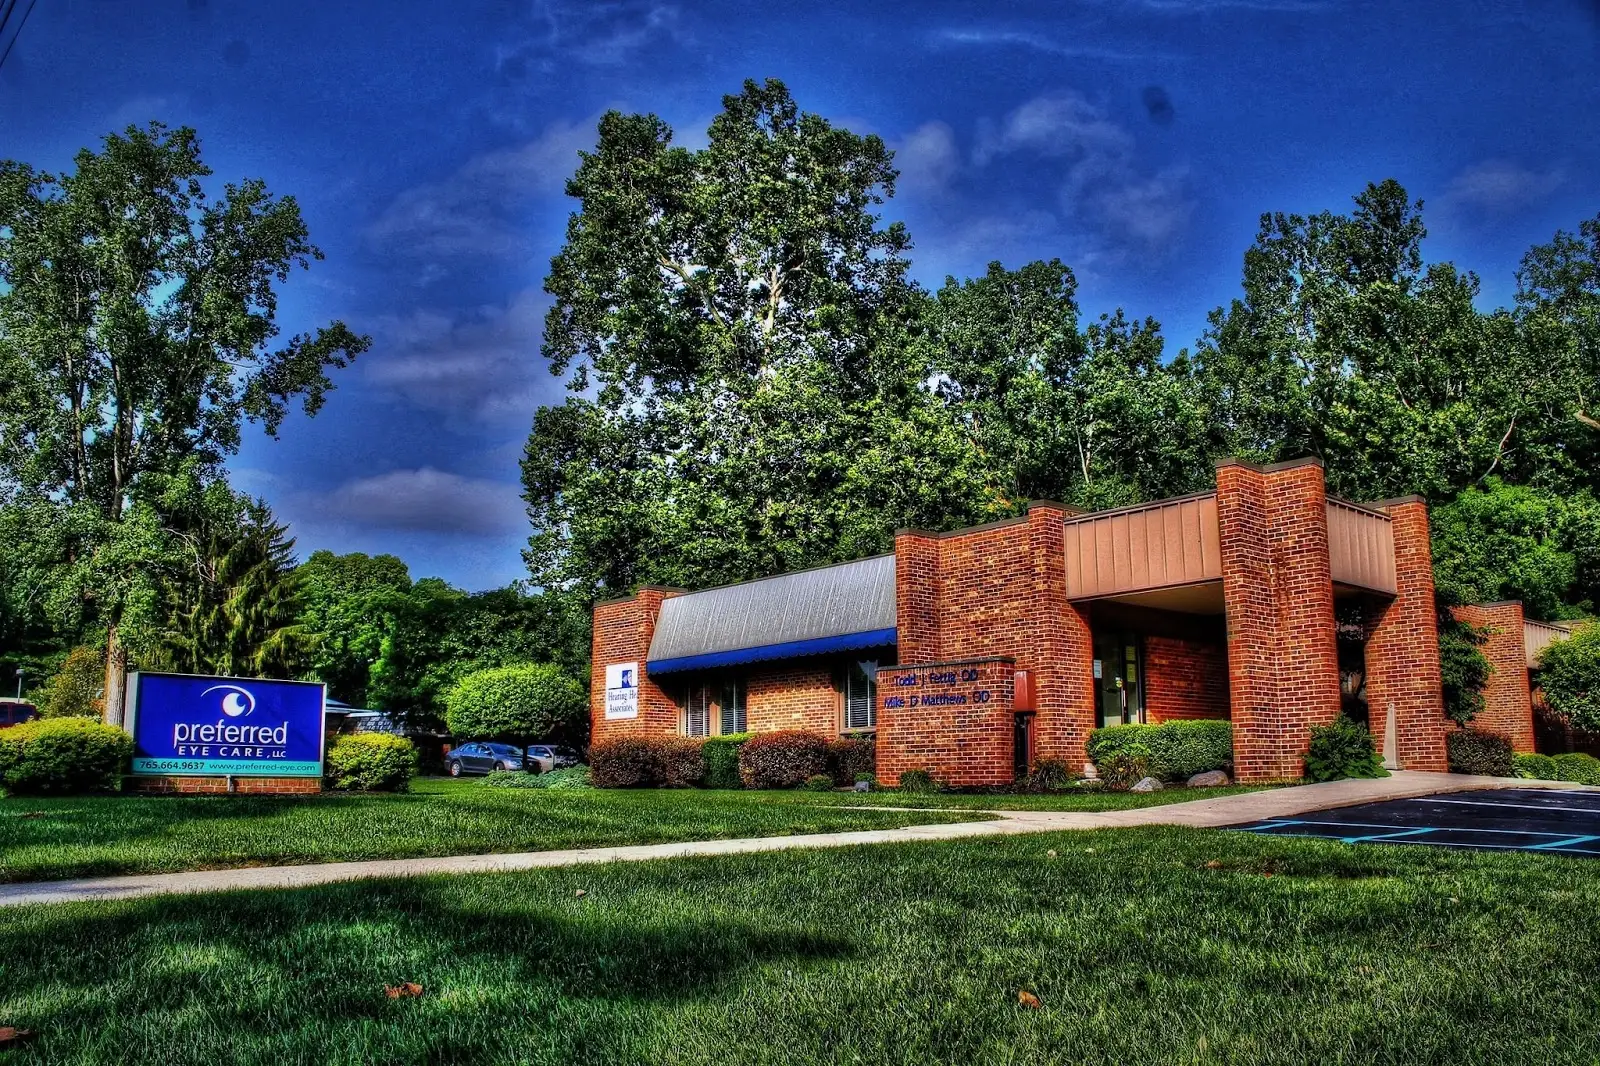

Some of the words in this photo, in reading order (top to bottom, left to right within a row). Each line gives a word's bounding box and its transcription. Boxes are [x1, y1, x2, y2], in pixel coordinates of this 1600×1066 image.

[894, 674, 916, 686] Todd
[885, 696, 904, 708] Mike
[922, 693, 967, 706] Matthews
[973, 691, 990, 703] OD
[174, 719, 289, 748] preferred
[178, 746, 210, 756] EYE
[140, 761, 205, 770] 765.664.9637
[209, 763, 316, 772] www.preferred-eye.com
